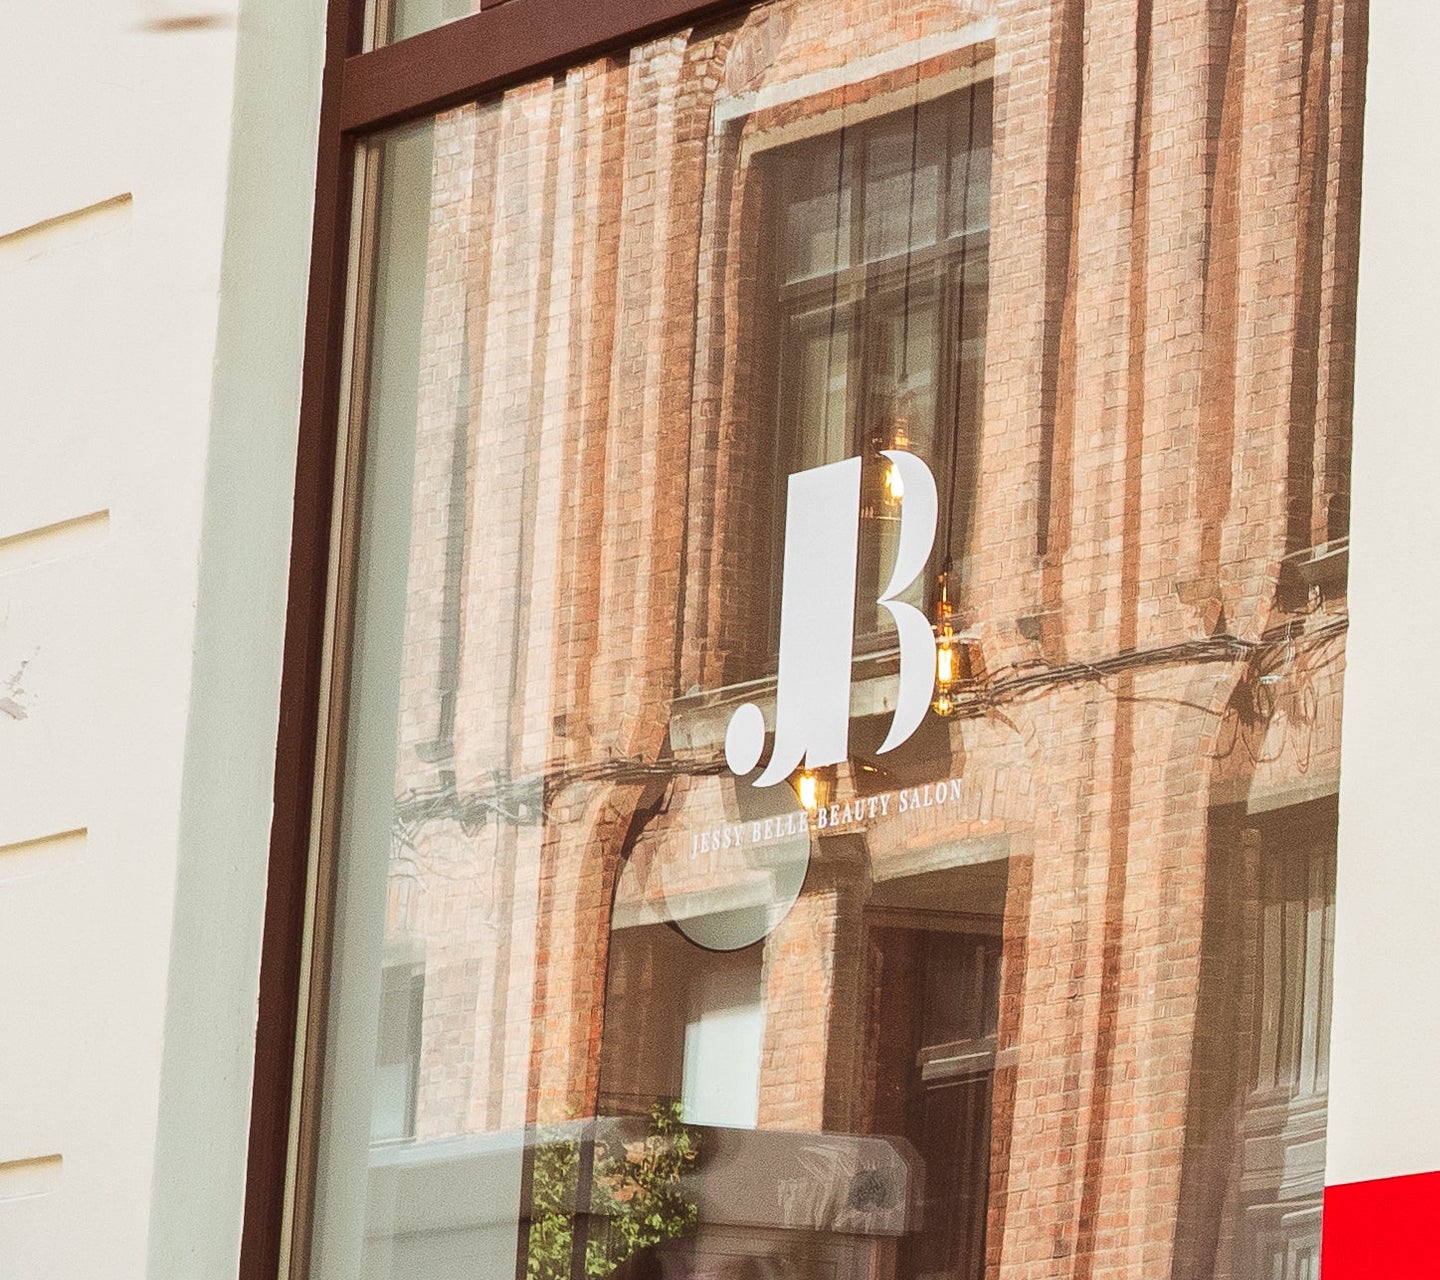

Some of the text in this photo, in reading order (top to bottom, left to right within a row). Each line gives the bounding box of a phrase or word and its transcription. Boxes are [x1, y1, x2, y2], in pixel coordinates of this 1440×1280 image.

[724, 449, 940, 788] JB
[690, 778, 963, 860] JESSY BELLE BEAUTY SALON
